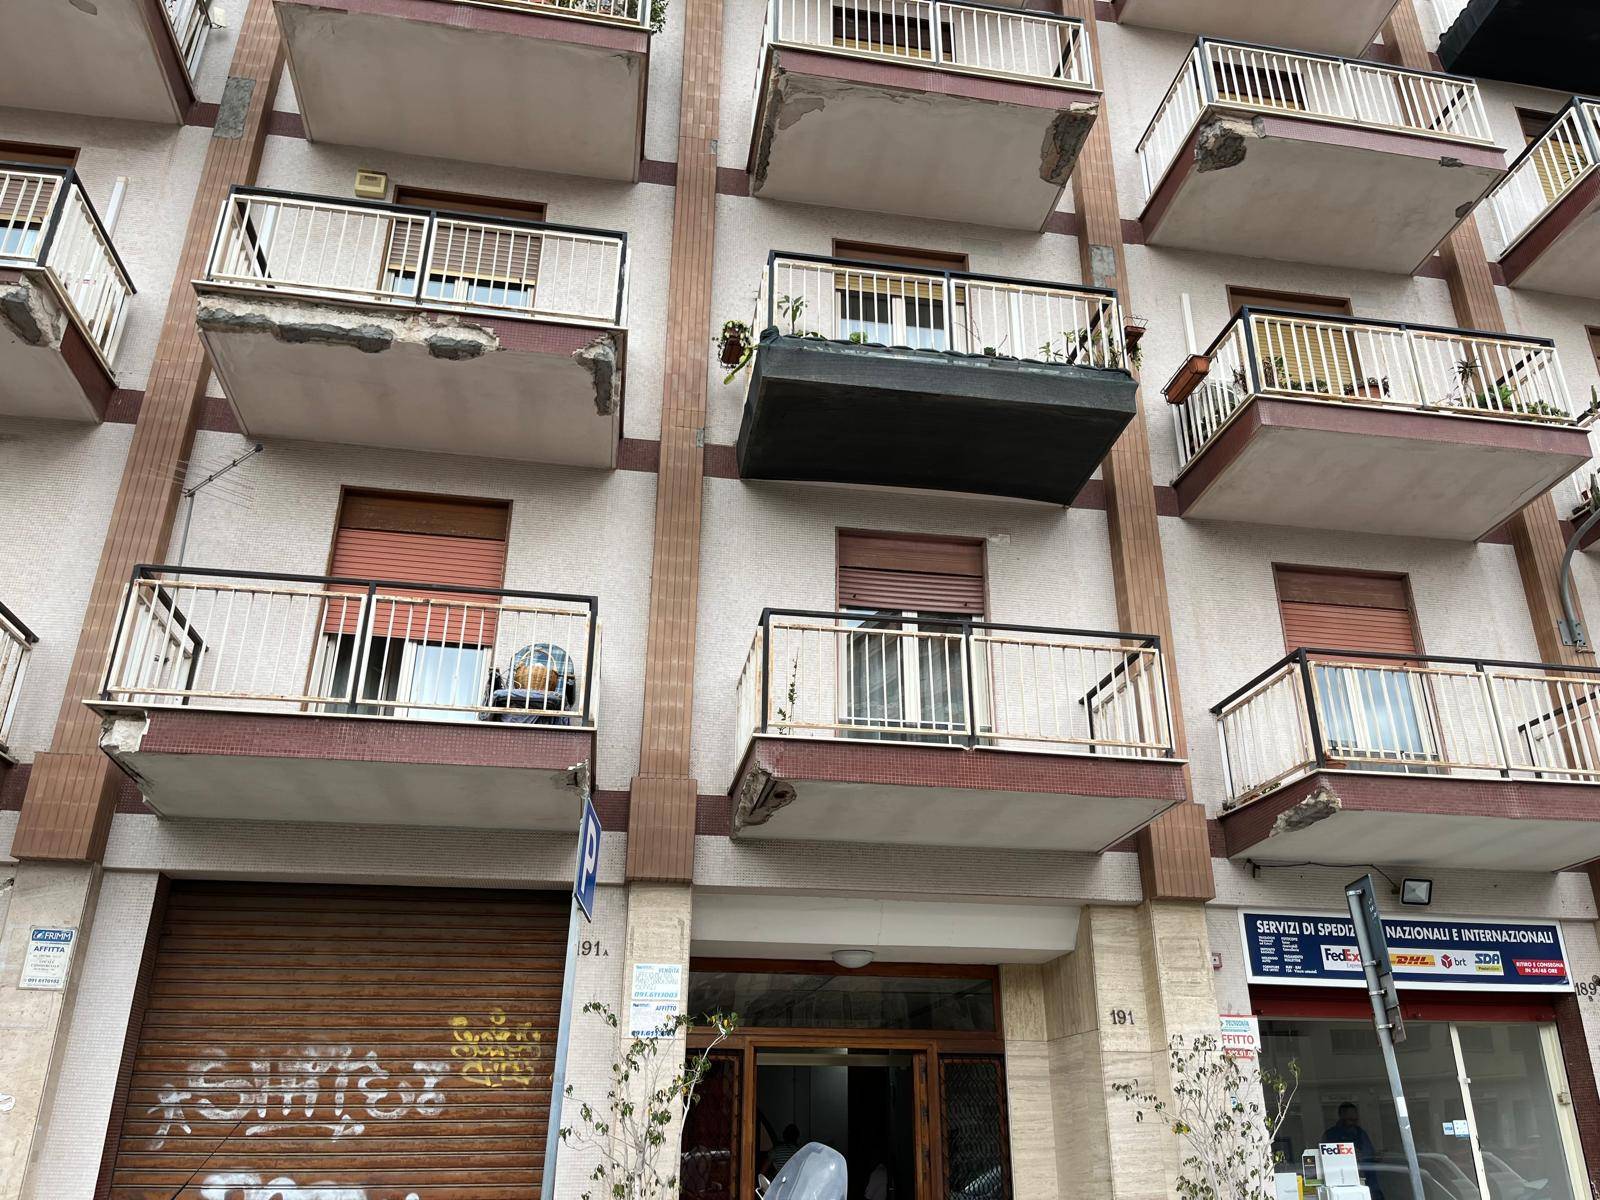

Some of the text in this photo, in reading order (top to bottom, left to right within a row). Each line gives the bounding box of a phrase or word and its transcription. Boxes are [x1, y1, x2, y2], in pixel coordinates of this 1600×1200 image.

[581, 814, 597, 895] P
[1256, 920, 1554, 944] SERVIZI DI SPEDIZ NAZIONALI E INTERNAZIONALI
[1325, 948, 1360, 962] FedEx
[1396, 955, 1429, 965] DHL
[1474, 953, 1500, 964] SDA
[1454, 957, 1467, 967] brt
[1575, 981, 1597, 996] 189
[655, 1004, 677, 1012] AFFITTO
[1110, 1009, 1134, 1025] 191
[1221, 1034, 1254, 1045] FFITTO
[1320, 1144, 1353, 1155] FedEx
